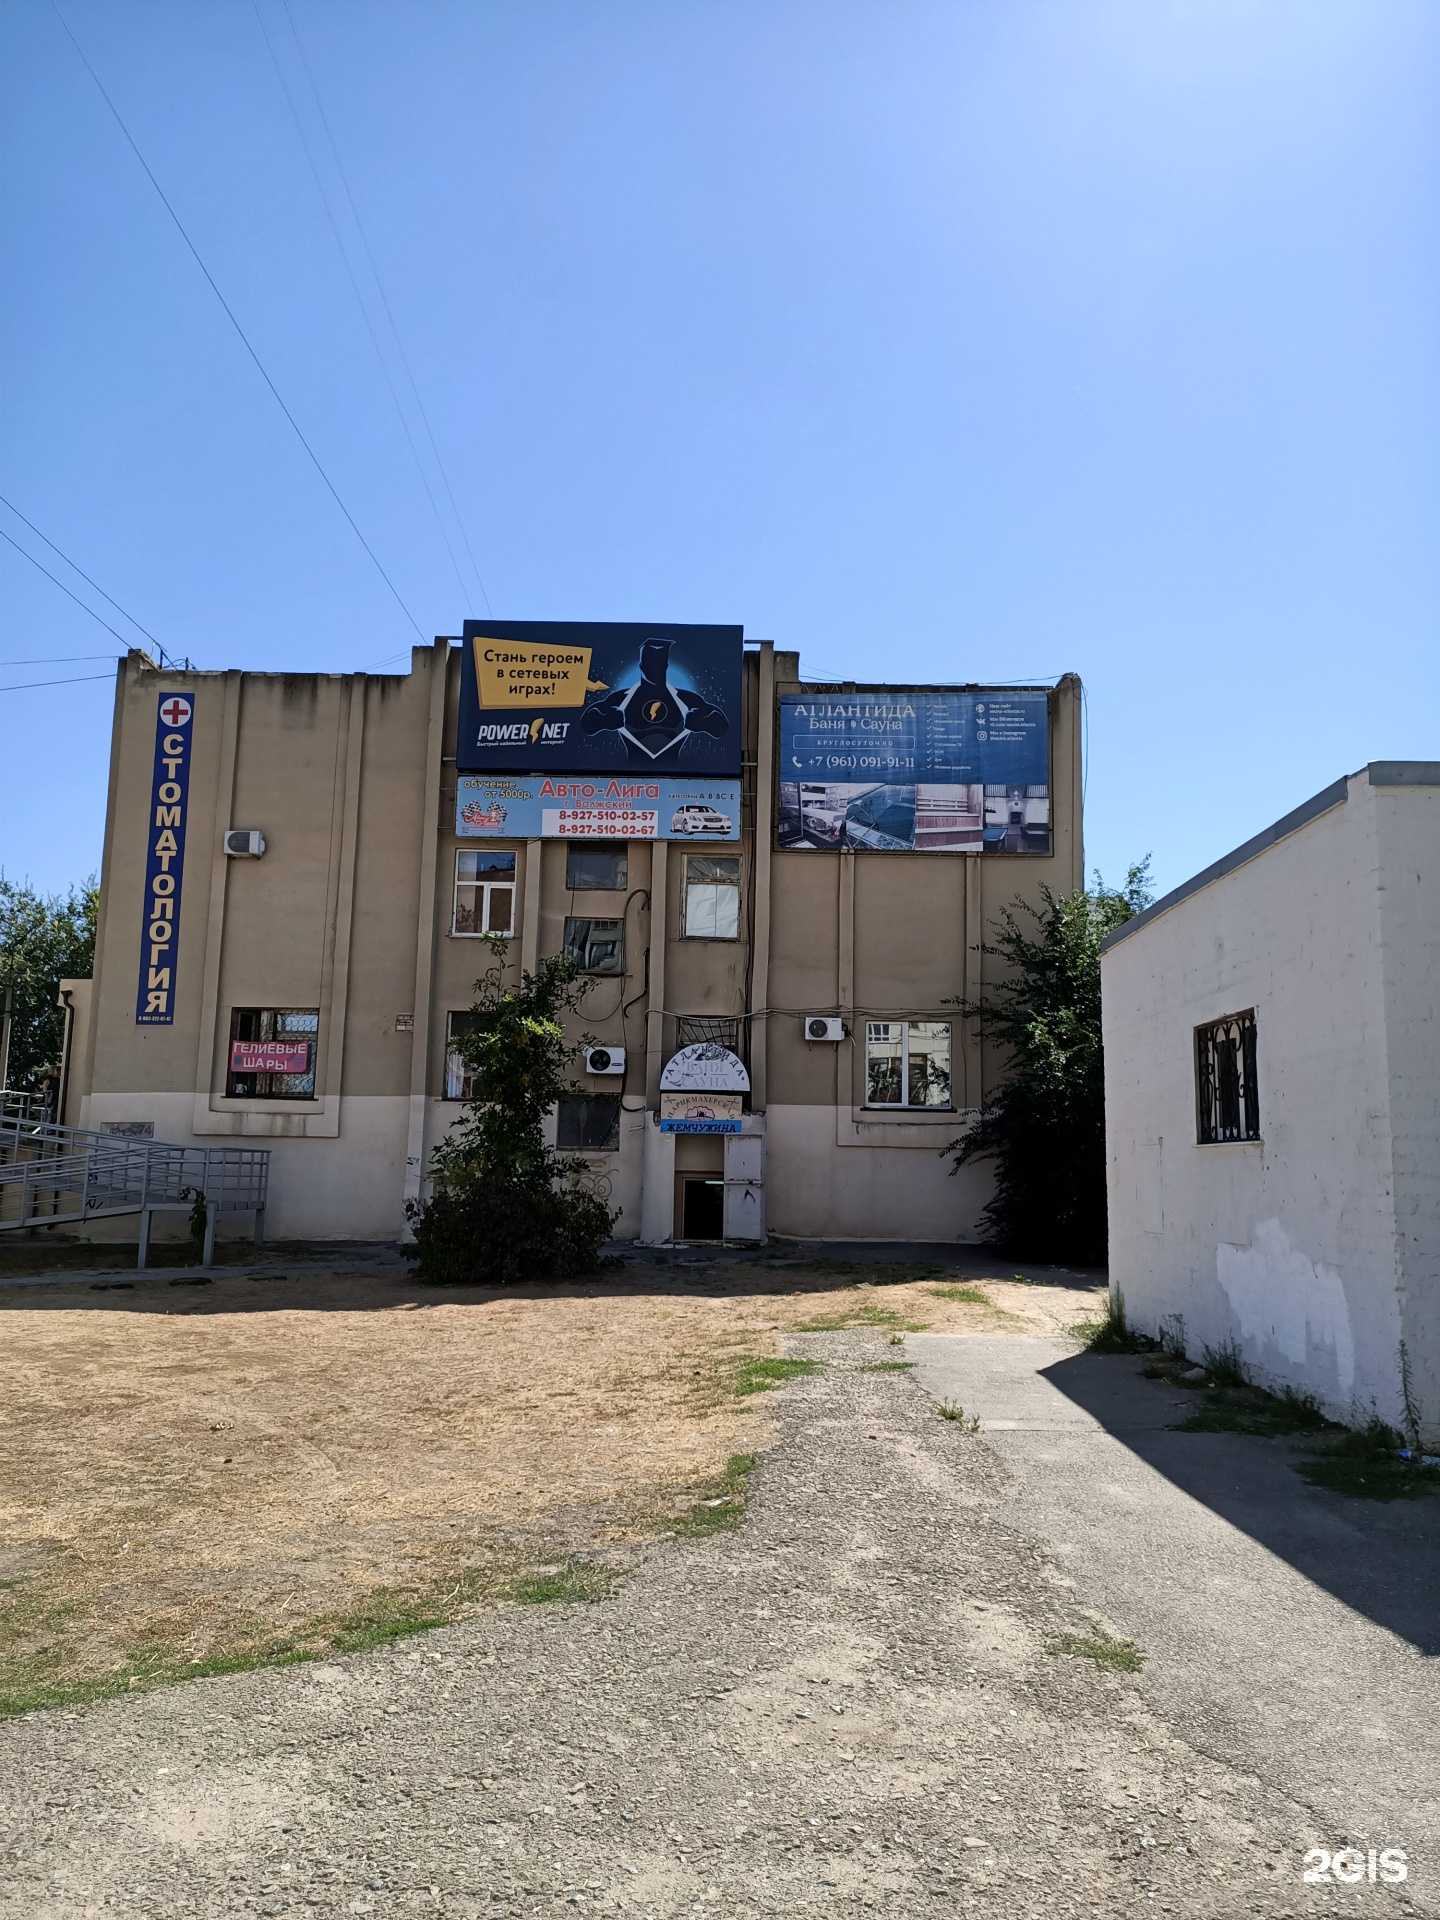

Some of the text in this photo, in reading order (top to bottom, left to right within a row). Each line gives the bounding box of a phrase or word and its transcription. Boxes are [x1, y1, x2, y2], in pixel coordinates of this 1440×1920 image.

[484, 649, 584, 668] Стань героем
[497, 669, 570, 679] в сетевых
[508, 682, 556, 698] играх!
[794, 704, 917, 718] АТЛАНТИДА
[809, 717, 903, 732] Баня Сауна
[478, 723, 571, 740] POWER NET
[808, 755, 914, 768] +7 (961) 091-91-11
[484, 790, 497, 798] от
[539, 779, 660, 799] Авто-Лига
[559, 811, 655, 821] 8-927-510-02-57
[559, 825, 655, 835] 8-927-510-02-67
[144, 733, 184, 1014] СТОМАТОЛОГИЯ
[233, 1043, 307, 1054] ГЕЛИЕВЫЕ
[243, 1057, 288, 1070] ШАРЫ
